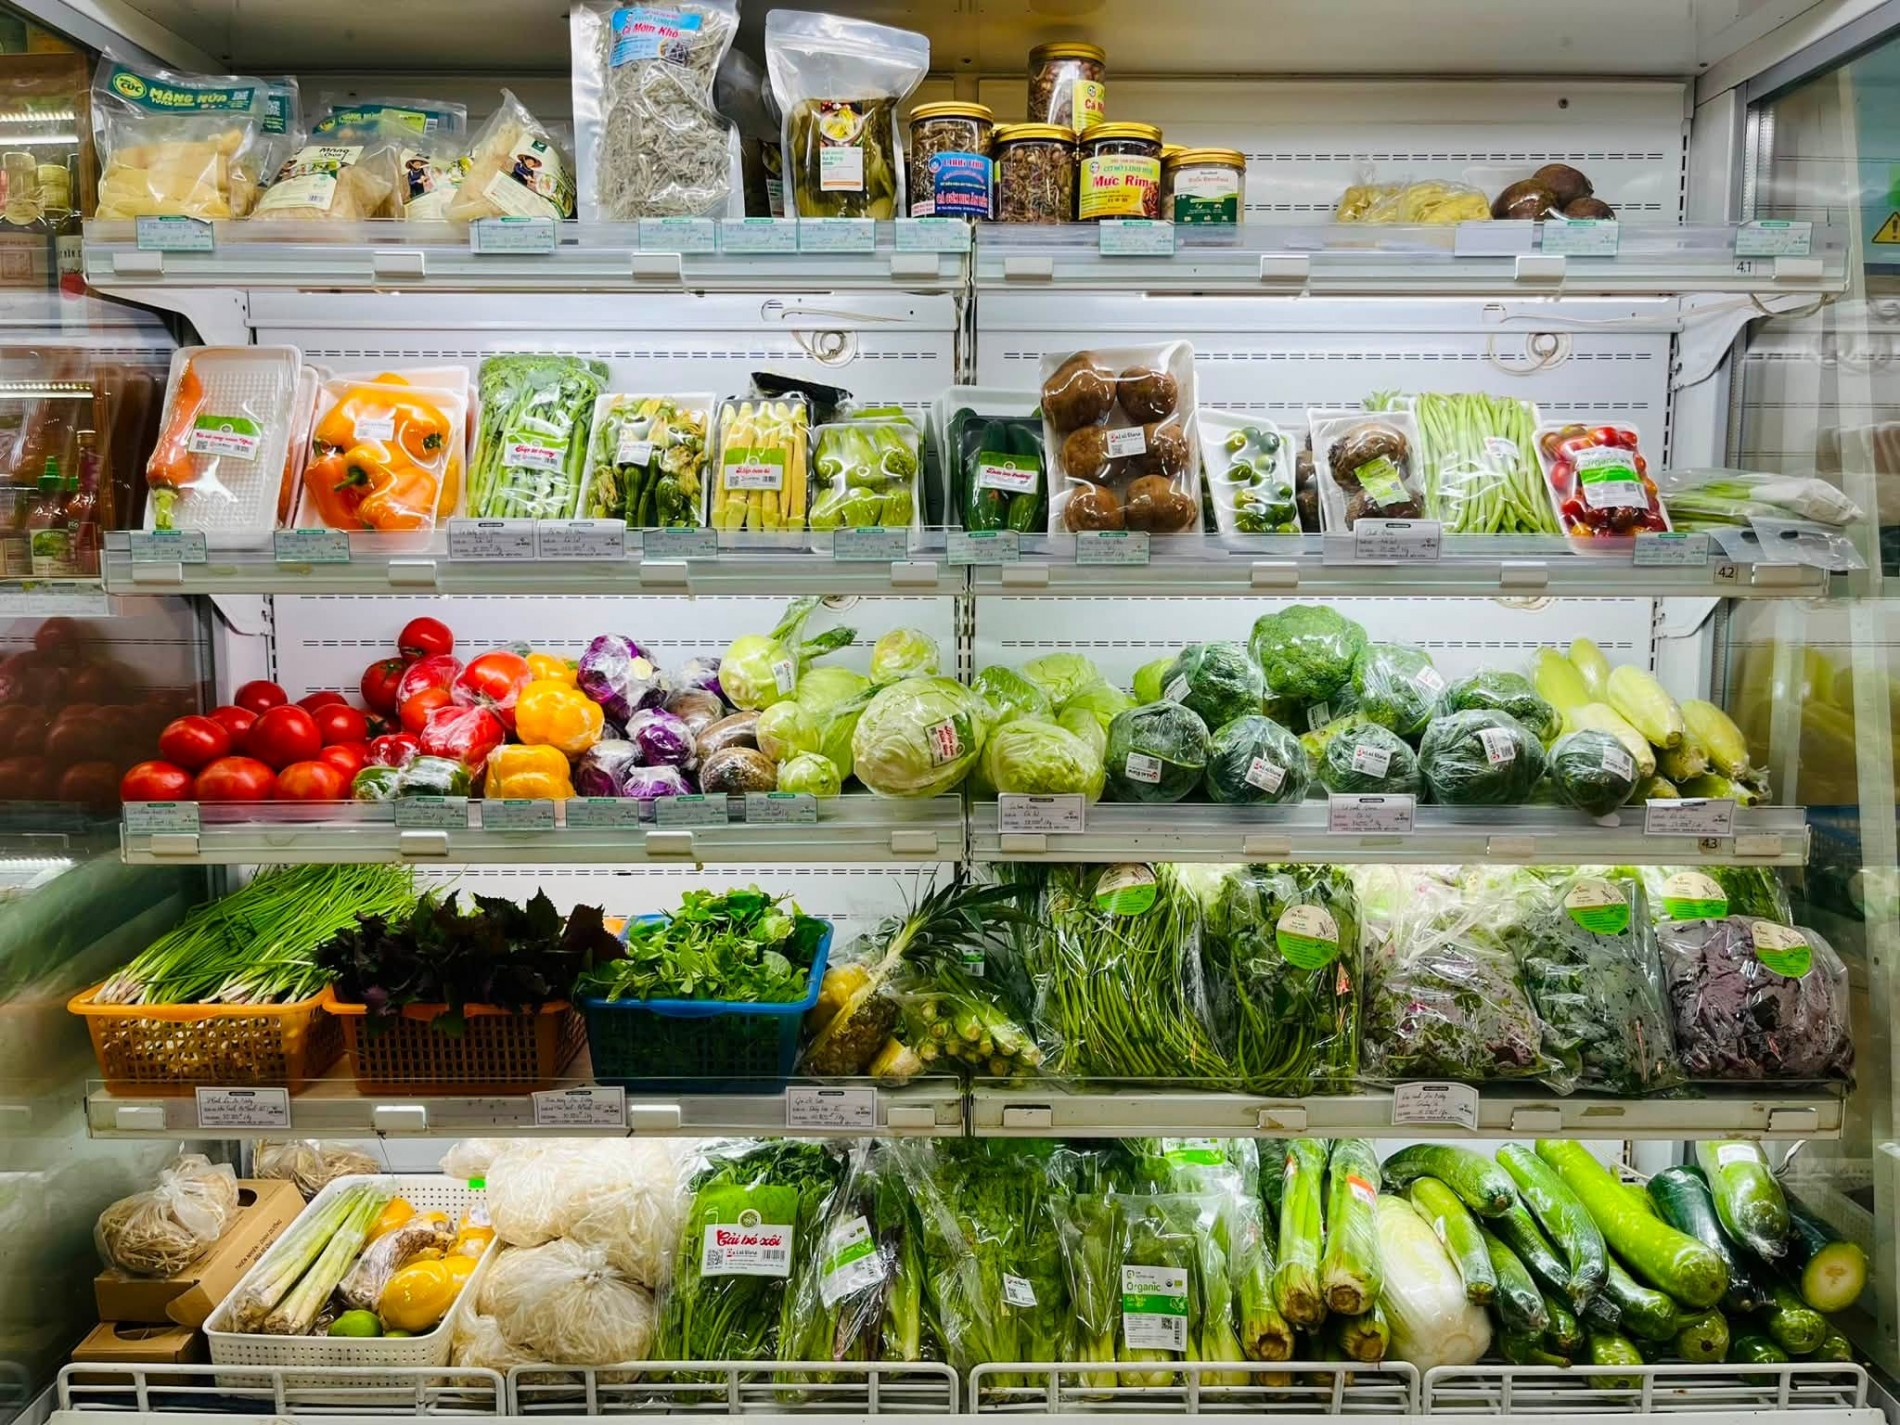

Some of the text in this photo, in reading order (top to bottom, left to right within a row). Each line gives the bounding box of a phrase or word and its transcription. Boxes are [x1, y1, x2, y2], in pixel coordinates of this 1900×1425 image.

[1126, 175, 1149, 188] Rim
[1736, 261, 1752, 273] 4.1
[741, 1233, 758, 1245] bó
[760, 1234, 782, 1246] xôi
[1127, 1281, 1161, 1293] Organic
